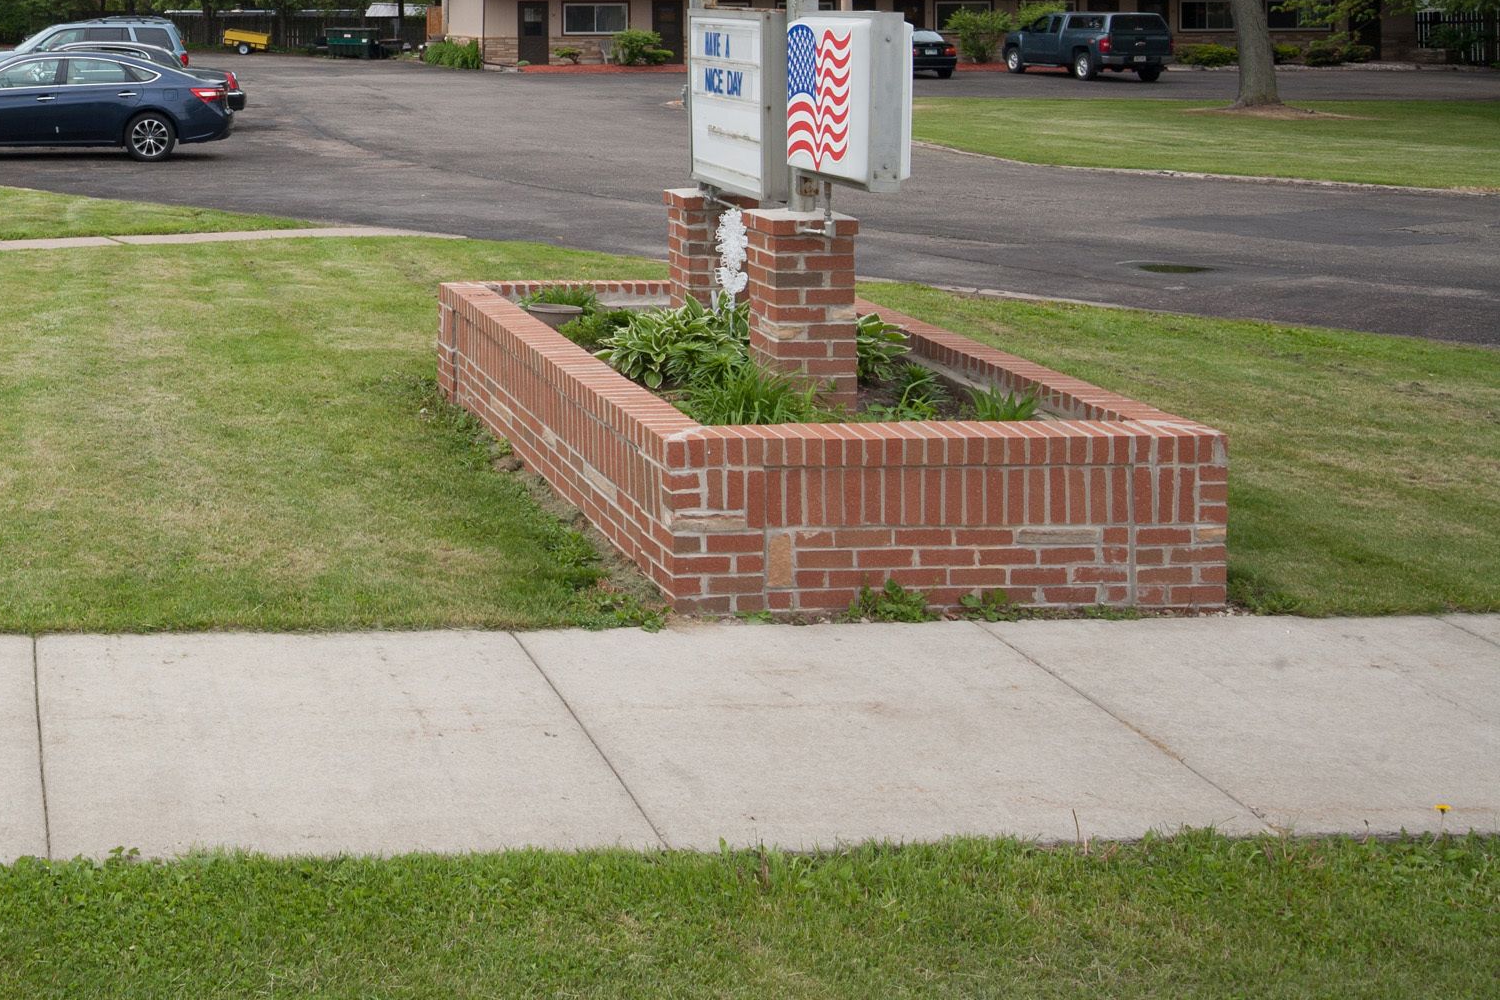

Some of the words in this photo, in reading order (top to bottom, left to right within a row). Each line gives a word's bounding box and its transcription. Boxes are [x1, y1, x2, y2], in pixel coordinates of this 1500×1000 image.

[705, 31, 721, 57] HAVE
[725, 33, 730, 58] A
[705, 67, 723, 94] NICE
[727, 71, 743, 96] DAY
